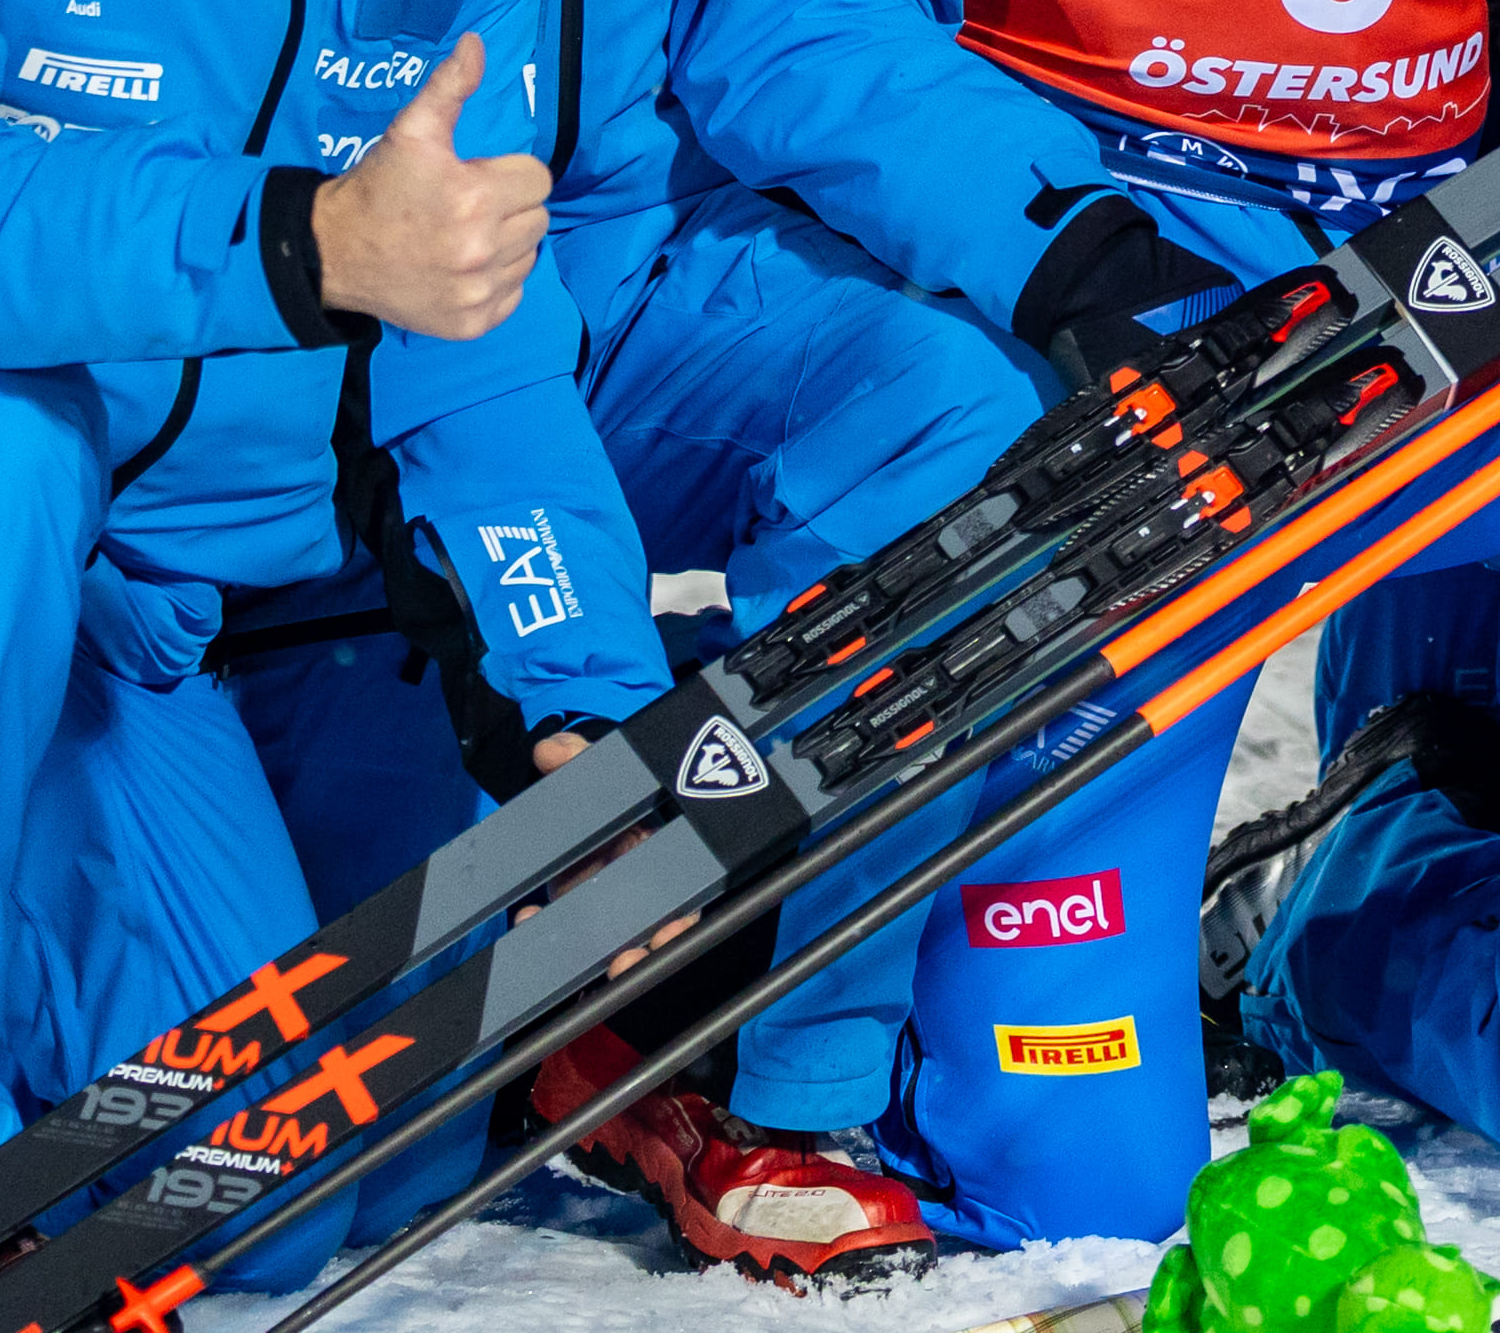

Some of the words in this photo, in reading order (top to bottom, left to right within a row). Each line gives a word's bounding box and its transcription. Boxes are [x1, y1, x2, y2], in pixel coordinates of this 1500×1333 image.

[65, 0, 101, 17] Audi
[18, 48, 163, 101] PIRELLI
[1129, 32, 1483, 103] ÖSTERSUND
[1442, 245, 1485, 298] ROSSIGNOL
[532, 508, 559, 552] ARMANI
[478, 525, 568, 637] EA7
[557, 563, 583, 617] EMPORIO
[802, 602, 859, 643] ROSSIGNOL
[870, 686, 927, 728] ROSSIGNOL
[713, 727, 758, 782] ROSSIGNOL
[984, 880, 1109, 940] enel
[1008, 1029, 1127, 1064] PIRELLI
[78, 1083, 194, 1130] 193
[147, 1166, 262, 1214] 193
